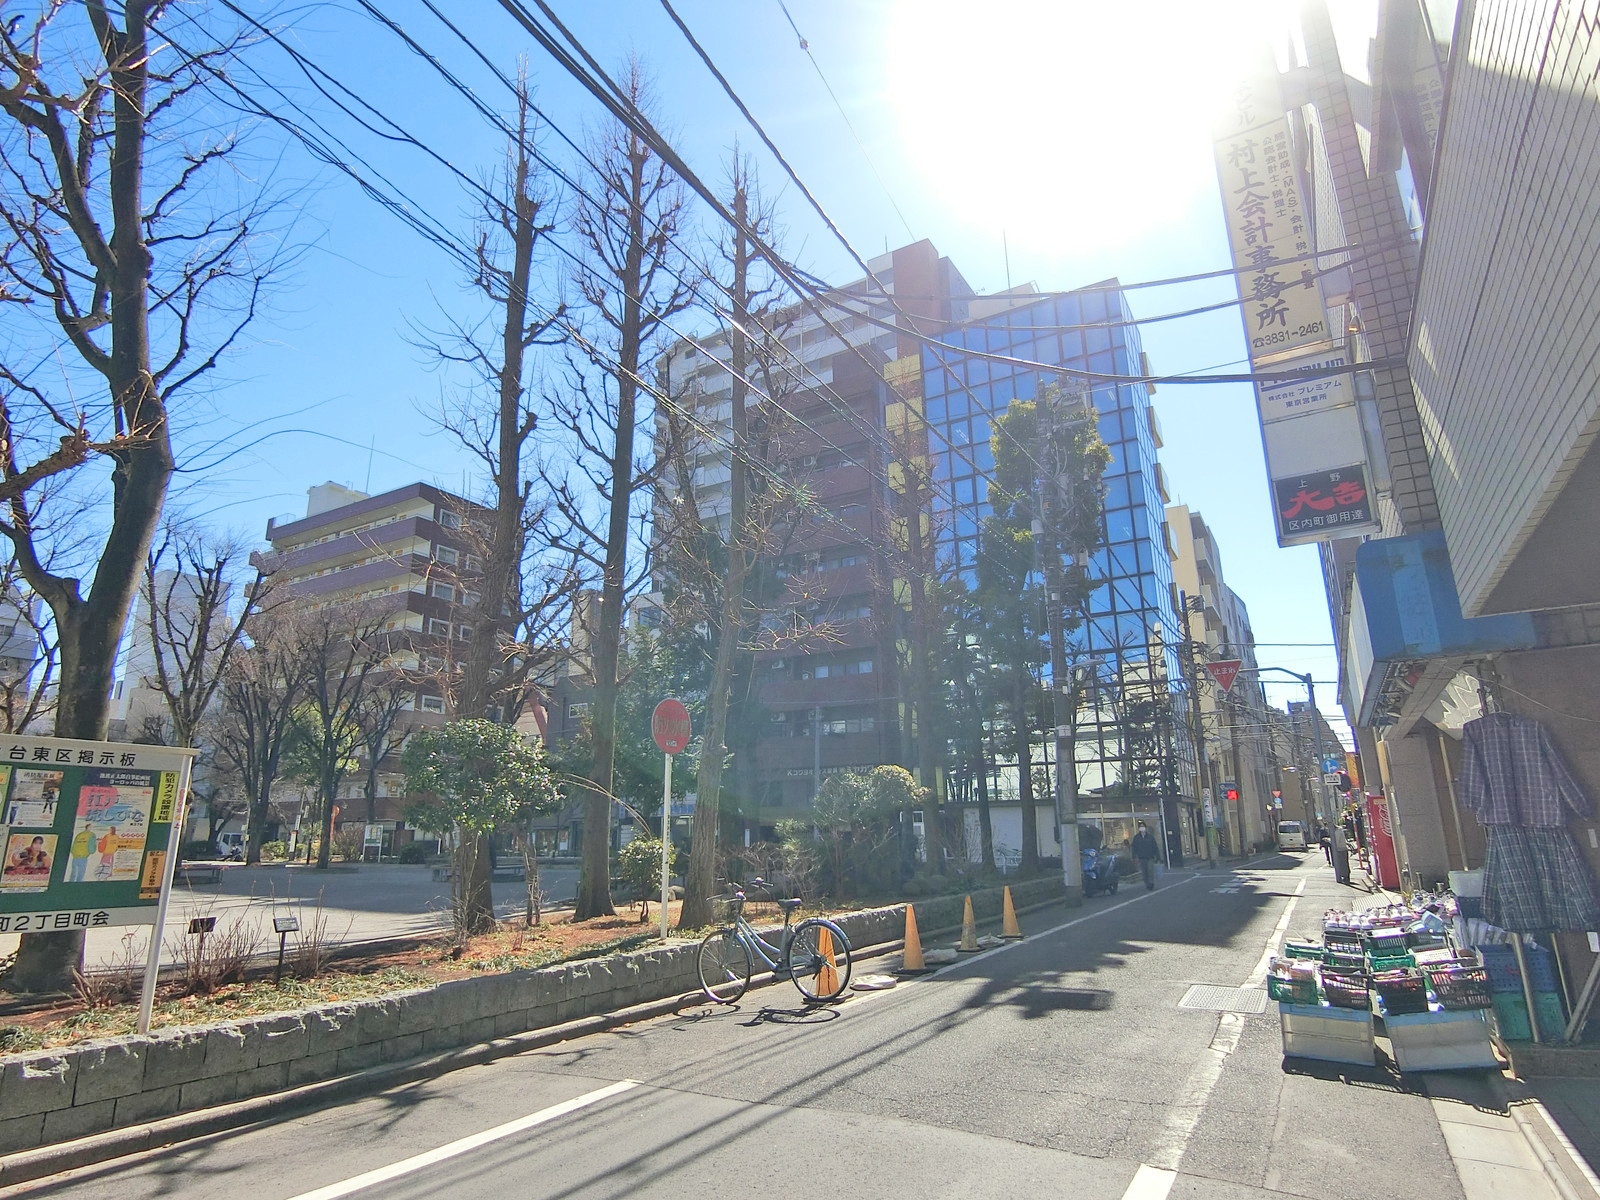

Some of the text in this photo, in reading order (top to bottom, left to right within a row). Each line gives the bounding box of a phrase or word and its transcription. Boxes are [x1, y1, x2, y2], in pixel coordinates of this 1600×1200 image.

[1226, 138, 1290, 331] 村上会計事務所
[1268, 380, 1342, 402] 株式会社 プレミアム
[1285, 392, 1328, 408] 東京営業所
[1281, 481, 1366, 519] 大吉
[1289, 508, 1364, 531] 区内町御用達
[1213, 667, 1236, 675] 止まれ
[9, 745, 136, 767] 台東区掲示板
